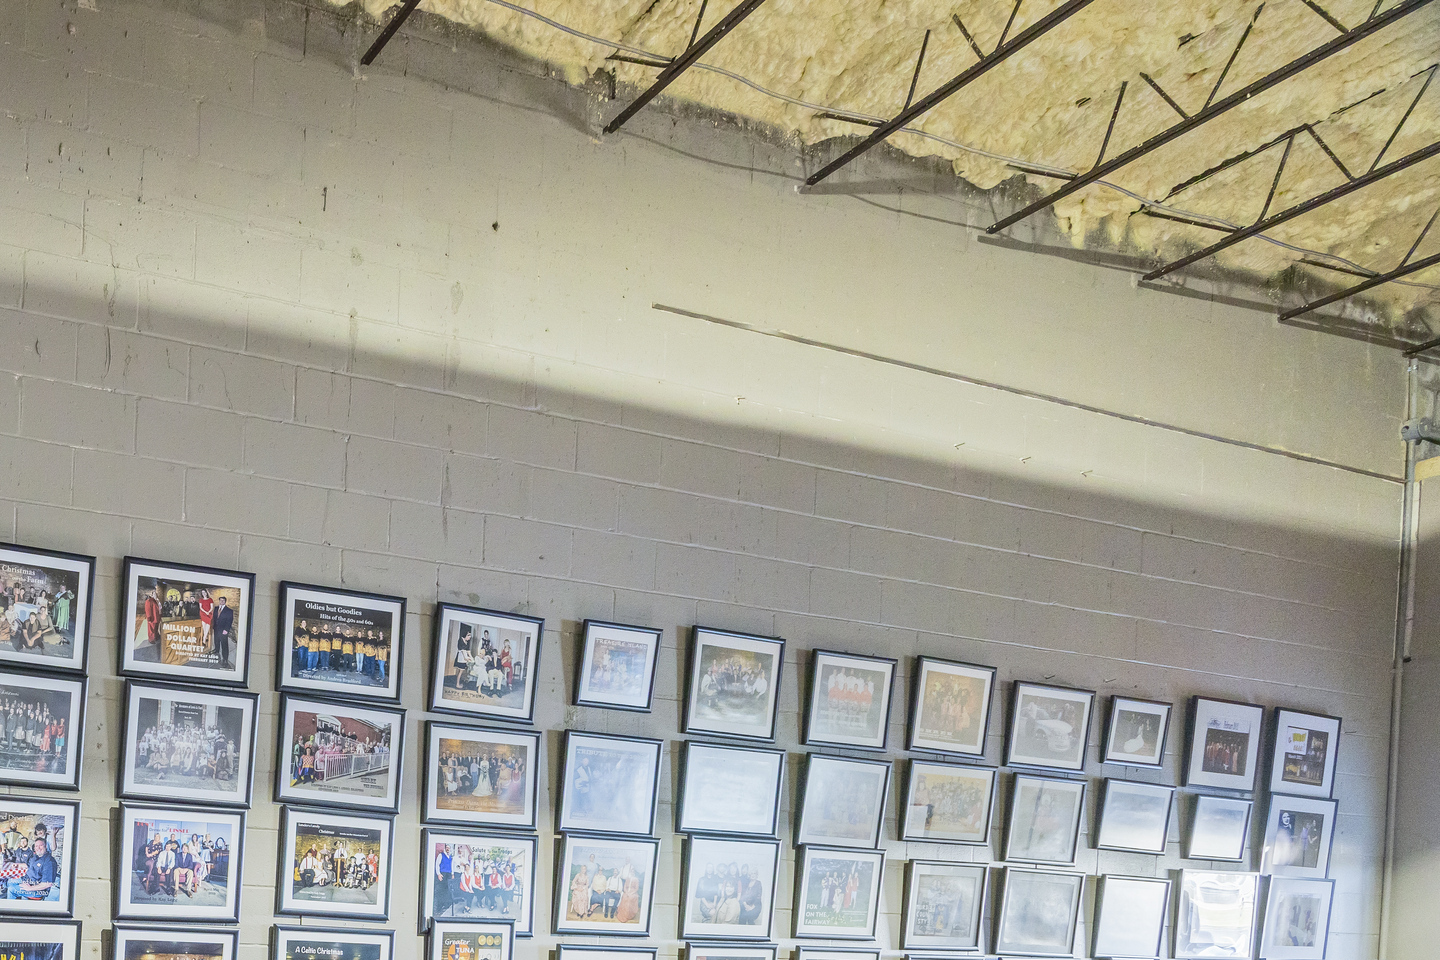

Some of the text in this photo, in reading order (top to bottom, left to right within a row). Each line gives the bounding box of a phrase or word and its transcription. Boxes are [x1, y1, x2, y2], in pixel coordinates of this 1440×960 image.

[1, 564, 35, 576] Christmas
[305, 603, 362, 616] Oldies but Goodies
[163, 623, 195, 633] MILLION
[167, 634, 197, 643] DOLLAR
[171, 643, 205, 652] QUARTET
[301, 946, 316, 954] Celtic
[317, 947, 343, 955] Christmas
